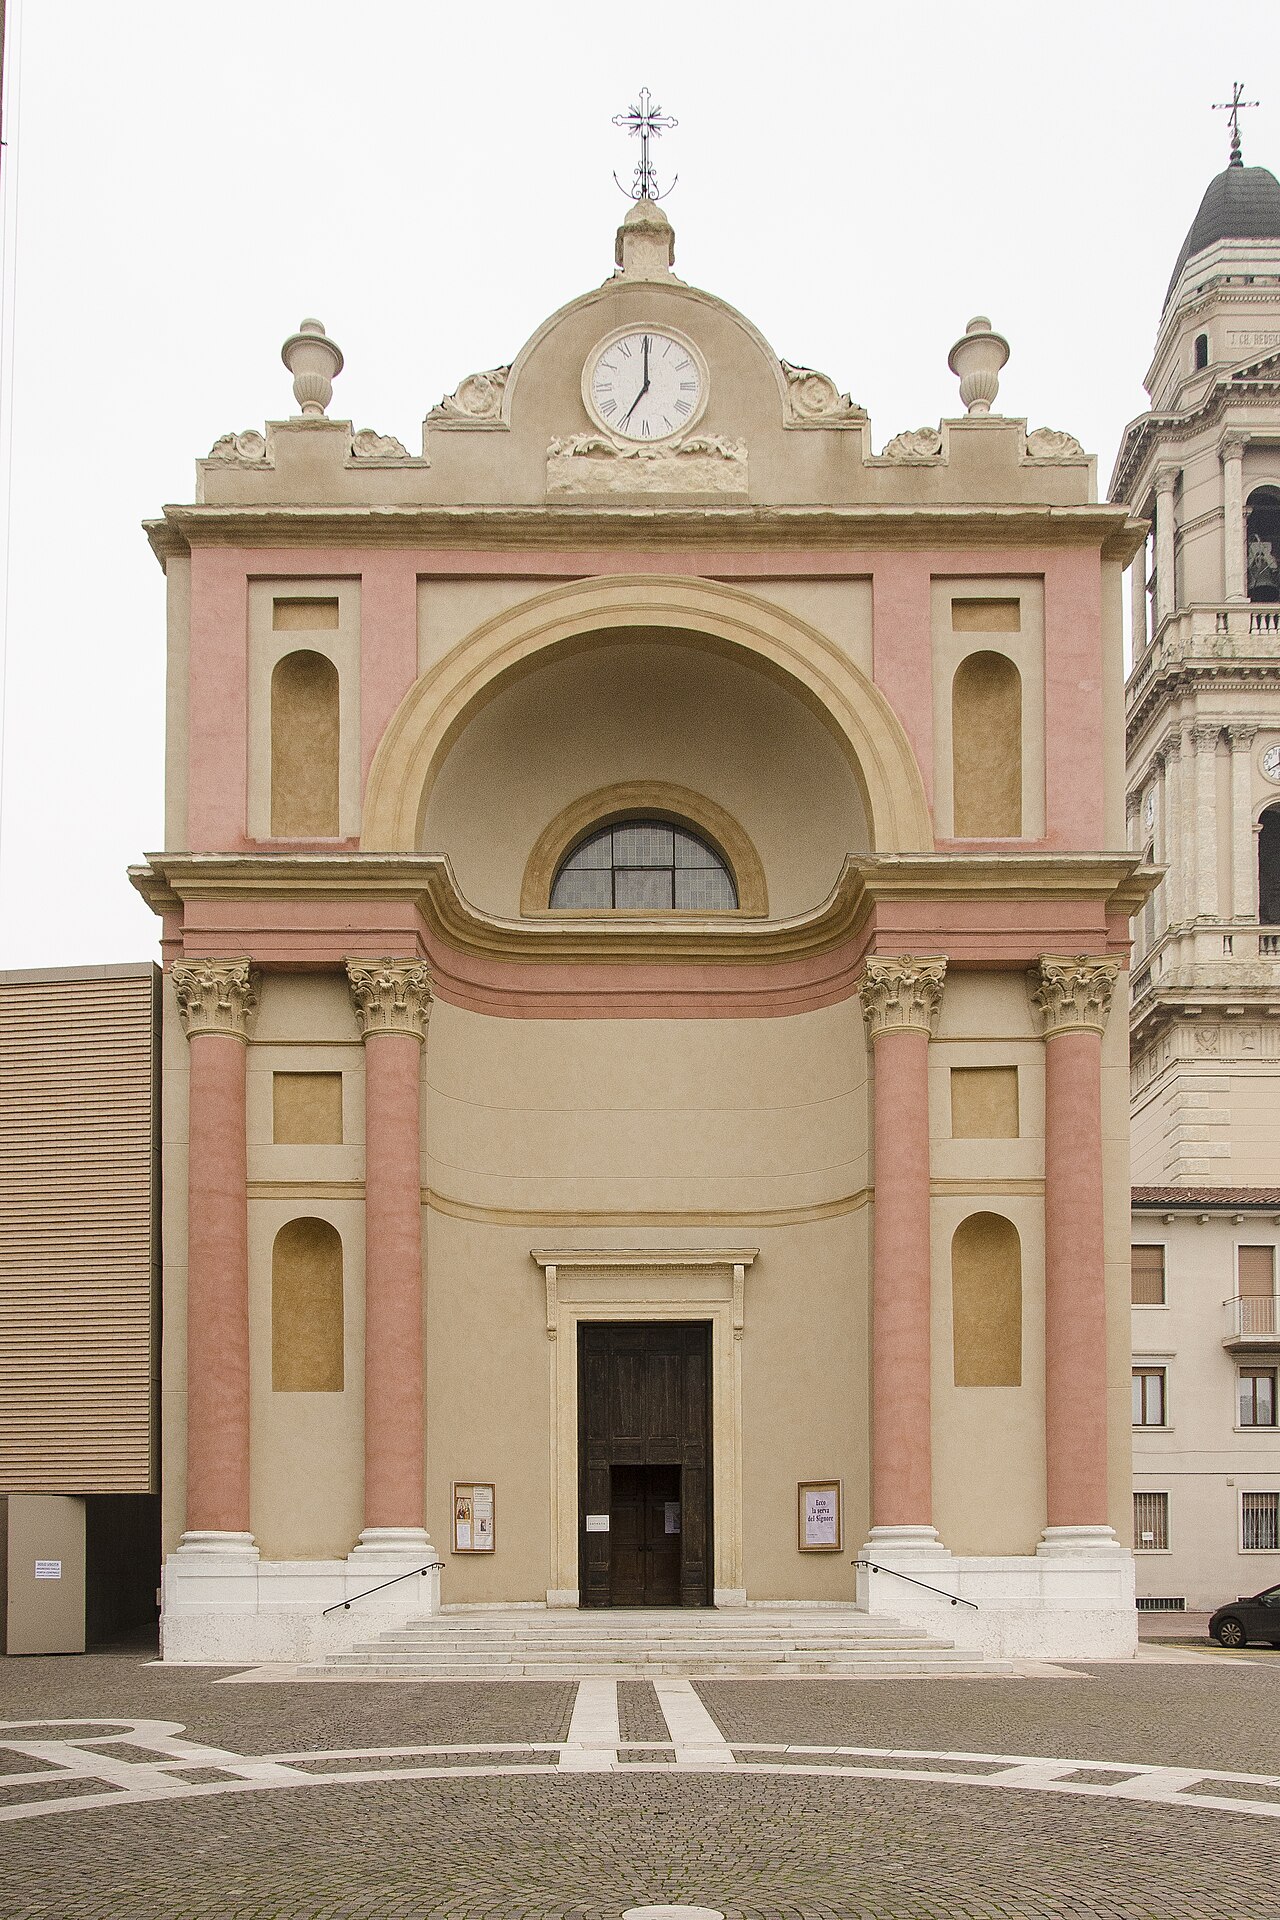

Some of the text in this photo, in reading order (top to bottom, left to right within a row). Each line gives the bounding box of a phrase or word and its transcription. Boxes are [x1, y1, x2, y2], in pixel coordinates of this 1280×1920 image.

[617, 341, 632, 360] XI
[602, 358, 617, 372] X
[675, 360, 690, 372] II
[596, 383, 613, 392] IX
[680, 382, 696, 391] III
[641, 420, 650, 435] VI
[662, 415, 674, 431] V
[816, 1514, 834, 1523] Signore
